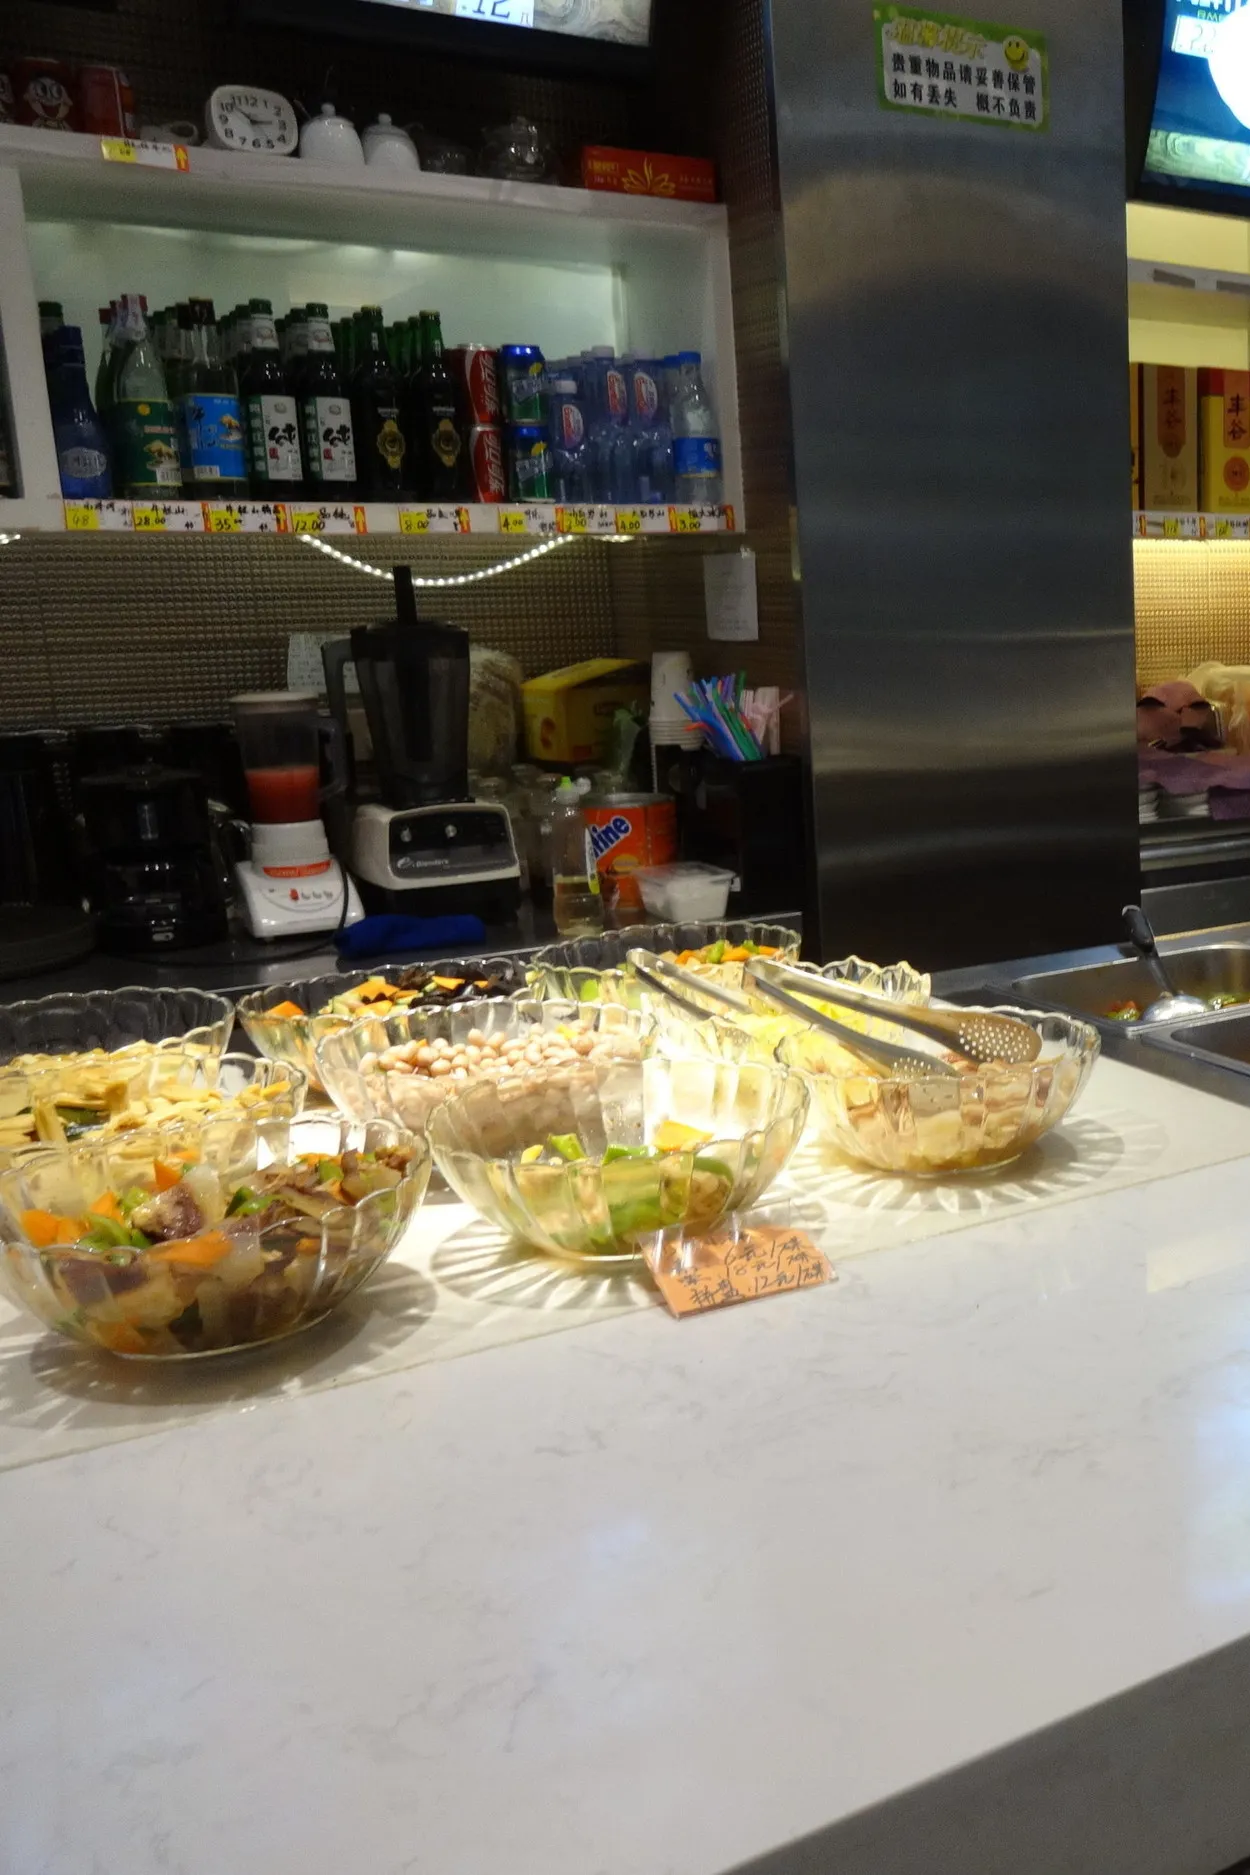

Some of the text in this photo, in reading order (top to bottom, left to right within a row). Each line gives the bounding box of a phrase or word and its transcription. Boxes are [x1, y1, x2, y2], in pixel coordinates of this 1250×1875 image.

[891, 52, 1037, 96] 贵重物品请妥善保管
[892, 78, 1037, 122] 如有丢失 概不负责
[219, 113, 229, 125] 9
[224, 127, 234, 140] 8
[238, 135, 248, 146] 7
[1227, 393, 1247, 442] 丰谷
[294, 520, 326, 533] 12.00
